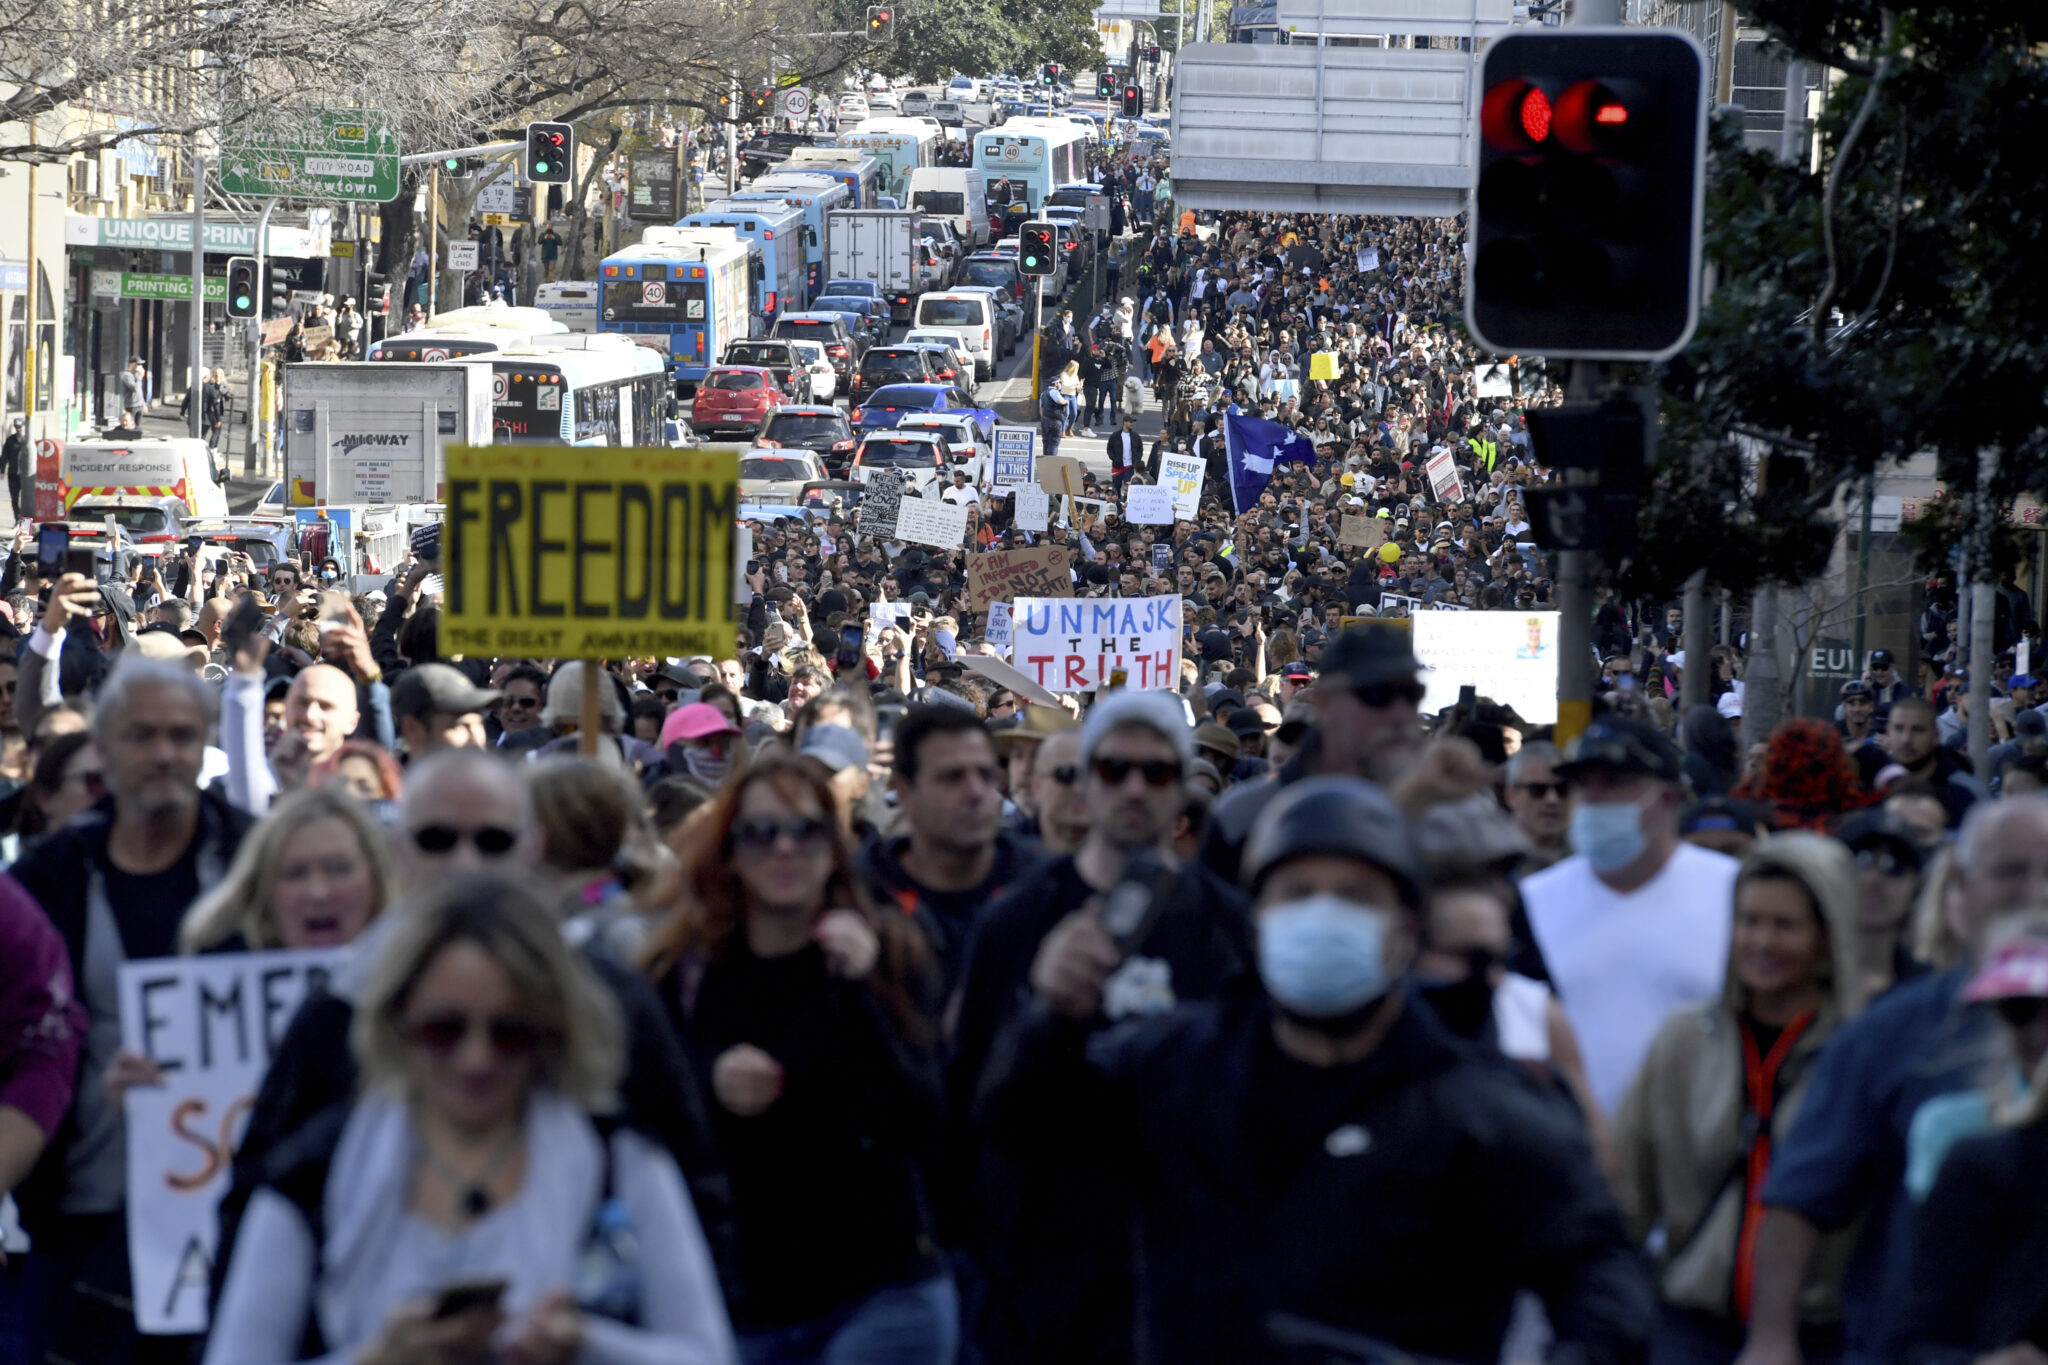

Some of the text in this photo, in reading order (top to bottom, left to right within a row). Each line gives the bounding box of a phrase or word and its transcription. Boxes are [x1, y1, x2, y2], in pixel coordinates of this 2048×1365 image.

[789, 97, 805, 108] 40
[338, 126, 365, 138] A22
[1006, 148, 1017, 156] 40
[104, 220, 190, 241] UNIQUE
[452, 252, 473, 260] LANE
[127, 280, 188, 294] PRINTING
[646, 287, 662, 299] 40
[343, 434, 410, 446] MICWAY
[1000, 432, 1029, 441] I'D LIKE TO
[69, 463, 173, 473] INCIDENT RESPONSE
[997, 463, 1029, 475] IN THIS
[1167, 460, 1201, 473] RISE UP
[1165, 466, 1198, 481] SPEAK
[1020, 485, 1032, 495] WE
[1177, 480, 1198, 495] UP
[1018, 496, 1043, 507] NOT
[450, 478, 739, 622] FREEDOM
[970, 552, 1011, 573] I AM
[977, 567, 1049, 605] I DO NOT
[1026, 598, 1177, 636] UNMASK
[449, 628, 489, 648] THE
[496, 629, 564, 649] GREAT
[996, 629, 1009, 641] MY
[1068, 637, 1141, 653] THE
[1027, 648, 1173, 689] TRUTH
